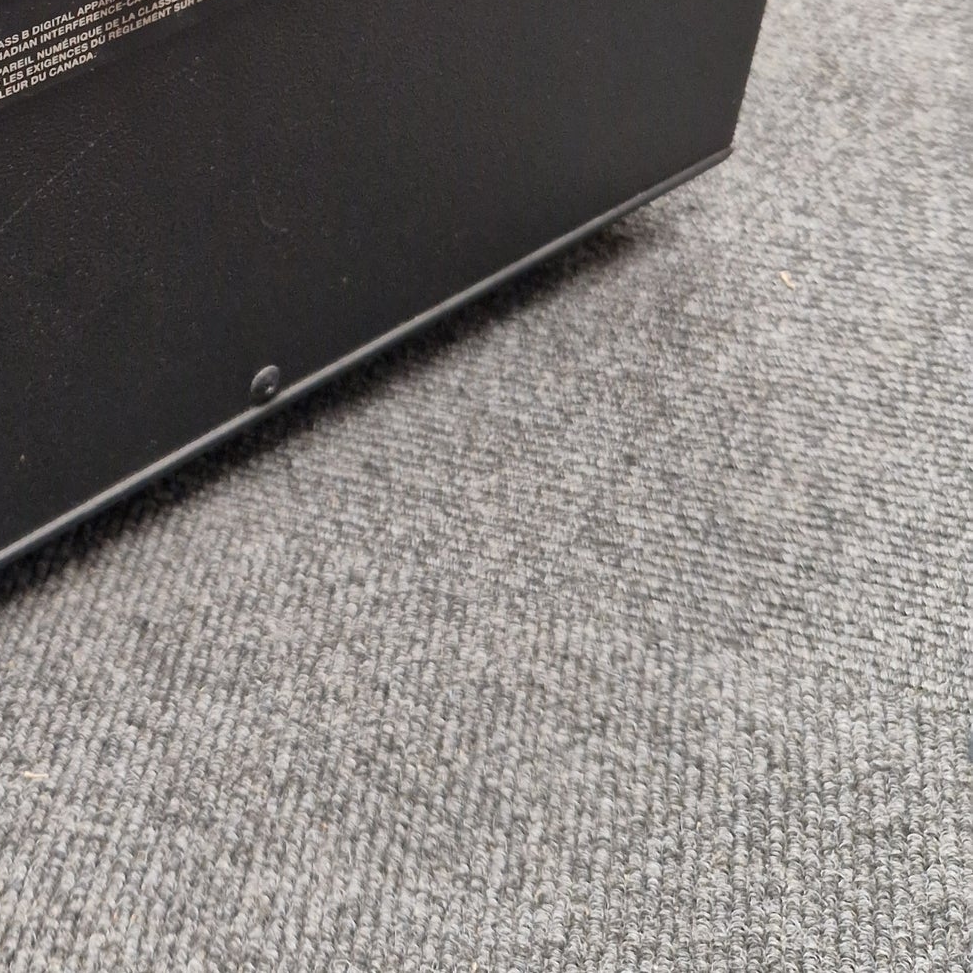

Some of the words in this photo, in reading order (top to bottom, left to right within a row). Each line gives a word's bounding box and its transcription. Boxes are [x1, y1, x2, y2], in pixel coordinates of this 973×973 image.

[20, 28, 30, 42] B
[31, 10, 75, 38] DIGITAL
[37, 25, 102, 62] NUMÉRIQUE
[105, 17, 120, 33] DE
[122, 10, 135, 25] LA
[3, 69, 24, 88] LES
[26, 41, 88, 78] EXIGENCES
[30, 70, 46, 88] DU
